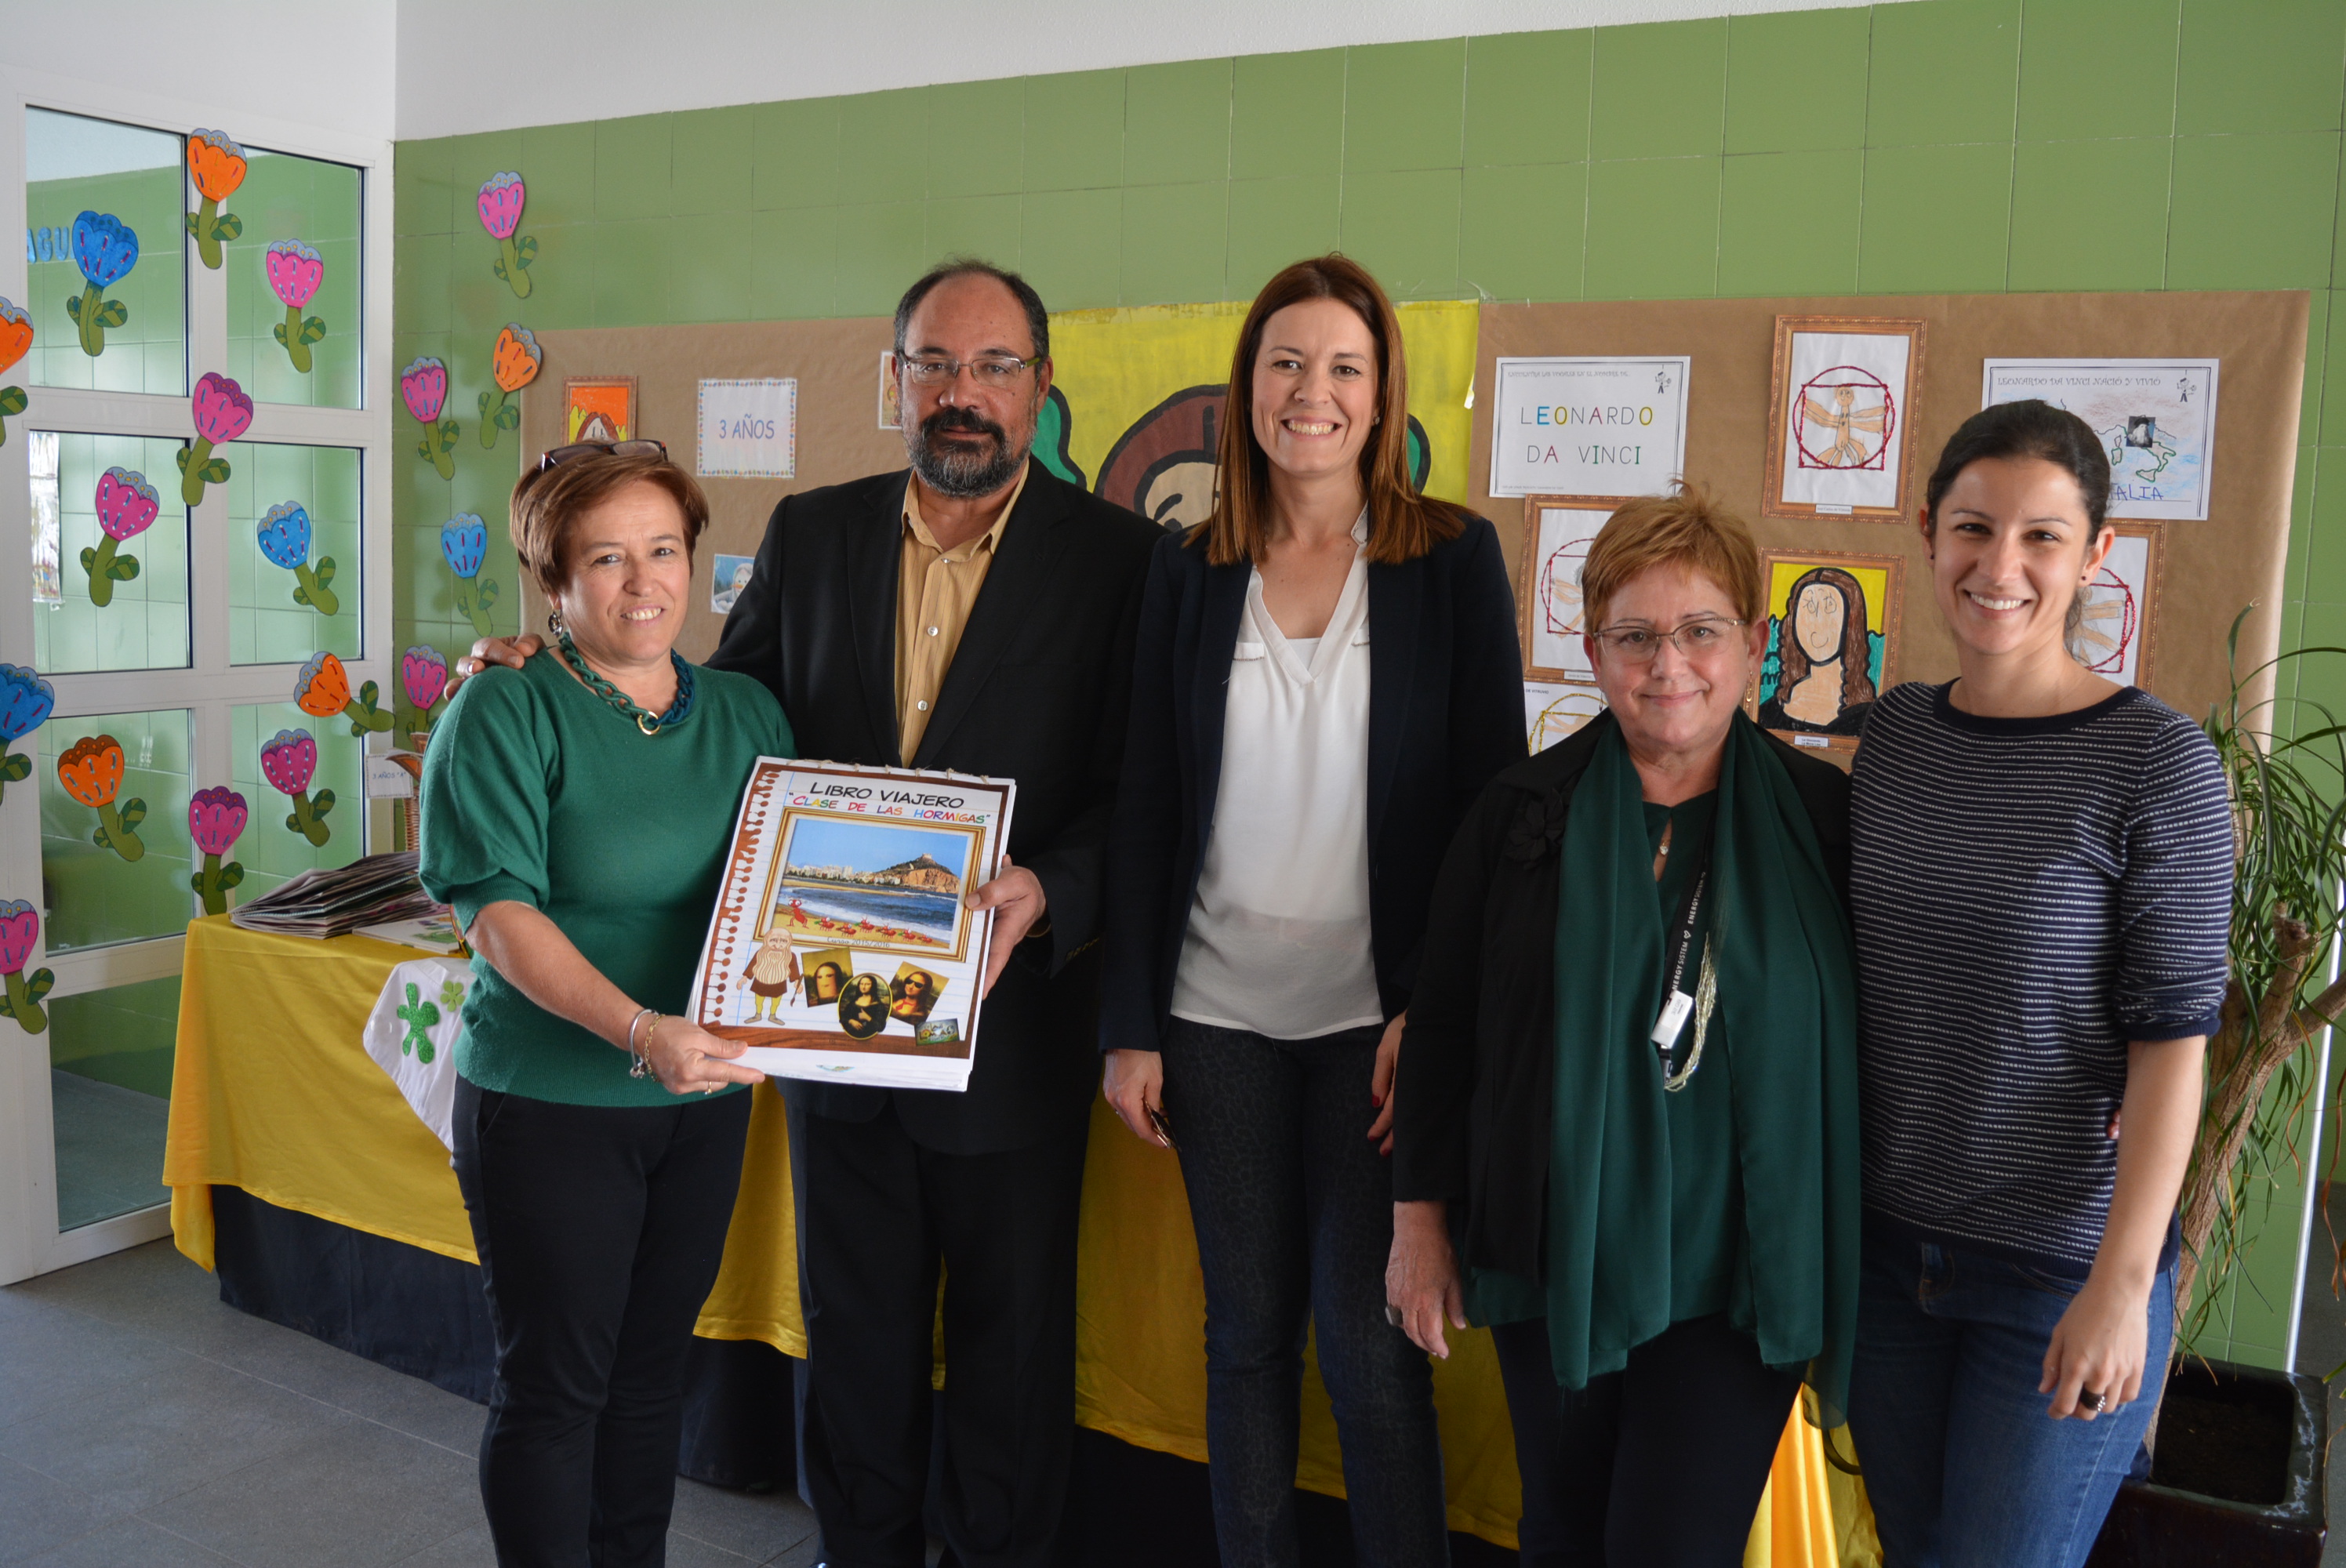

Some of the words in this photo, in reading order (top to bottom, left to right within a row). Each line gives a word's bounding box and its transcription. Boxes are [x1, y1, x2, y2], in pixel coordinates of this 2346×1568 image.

[1997, 377, 2047, 386] LEONARDO
[2066, 377, 2090, 386] VINCI
[2135, 376, 2161, 386] VIVIÓ
[1520, 406, 1653, 426] LEONARDO
[719, 419, 727, 439] 3
[732, 413, 775, 439] AÑOS
[1527, 445, 1559, 463] DA
[1578, 445, 1641, 464] VINCI
[809, 782, 873, 800] LIBRO
[881, 789, 964, 808] VIAJERO
[848, 802, 867, 812] DE
[877, 804, 903, 815] LAS
[1687, 898, 1699, 924] ENERGY
[852, 939, 890, 948] 2015/2016
